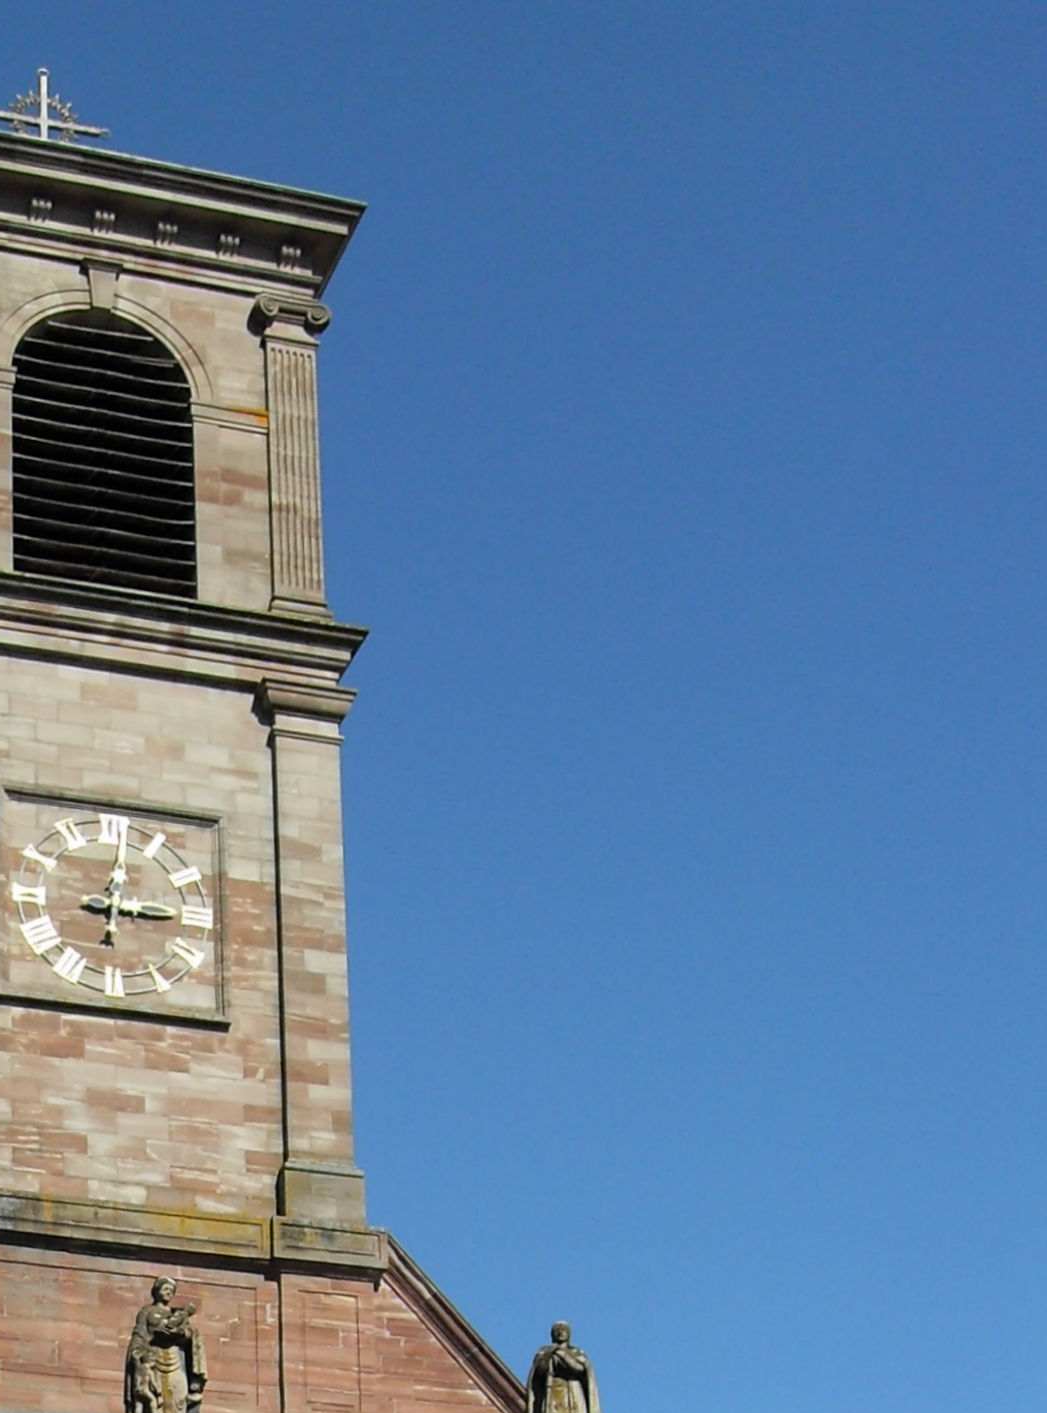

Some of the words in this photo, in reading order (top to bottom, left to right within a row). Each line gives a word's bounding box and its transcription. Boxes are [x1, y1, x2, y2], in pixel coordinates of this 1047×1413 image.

[54, 817, 87, 851] XI
[21, 843, 57, 872] X
[169, 865, 201, 888] II
[11, 882, 47, 906] IX
[181, 905, 214, 929] III
[20, 915, 62, 955] VIII
[53, 946, 87, 984] VII
[172, 937, 205, 969] IV
[104, 966, 125, 997] VI
[148, 963, 172, 994] V
